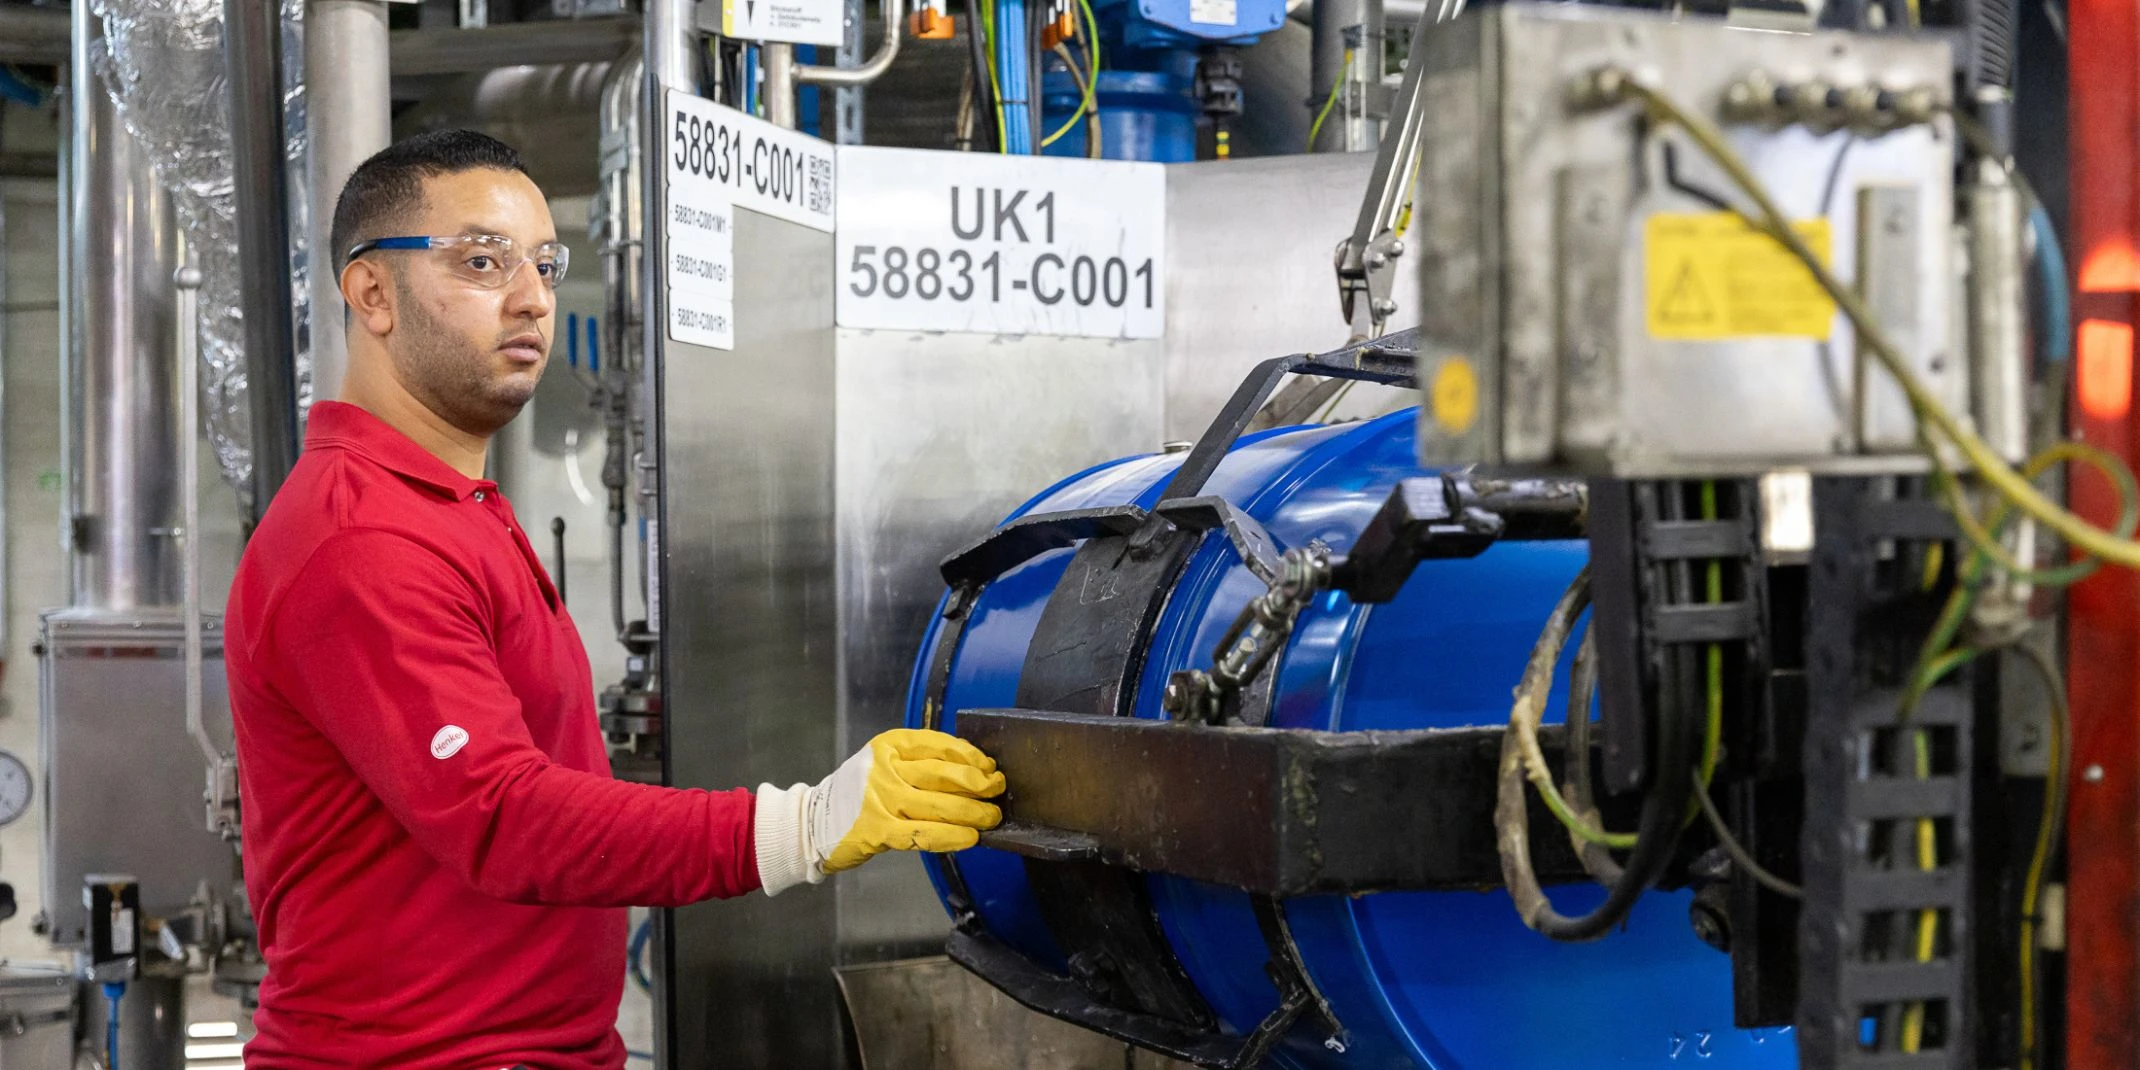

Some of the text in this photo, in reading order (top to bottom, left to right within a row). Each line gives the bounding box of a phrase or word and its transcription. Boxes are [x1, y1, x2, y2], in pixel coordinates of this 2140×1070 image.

[674, 110, 804, 207] 58831-C001
[950, 186, 1055, 244] UK1
[849, 245, 1154, 309] 58831-C001
[434, 731, 464, 754] Henkel
